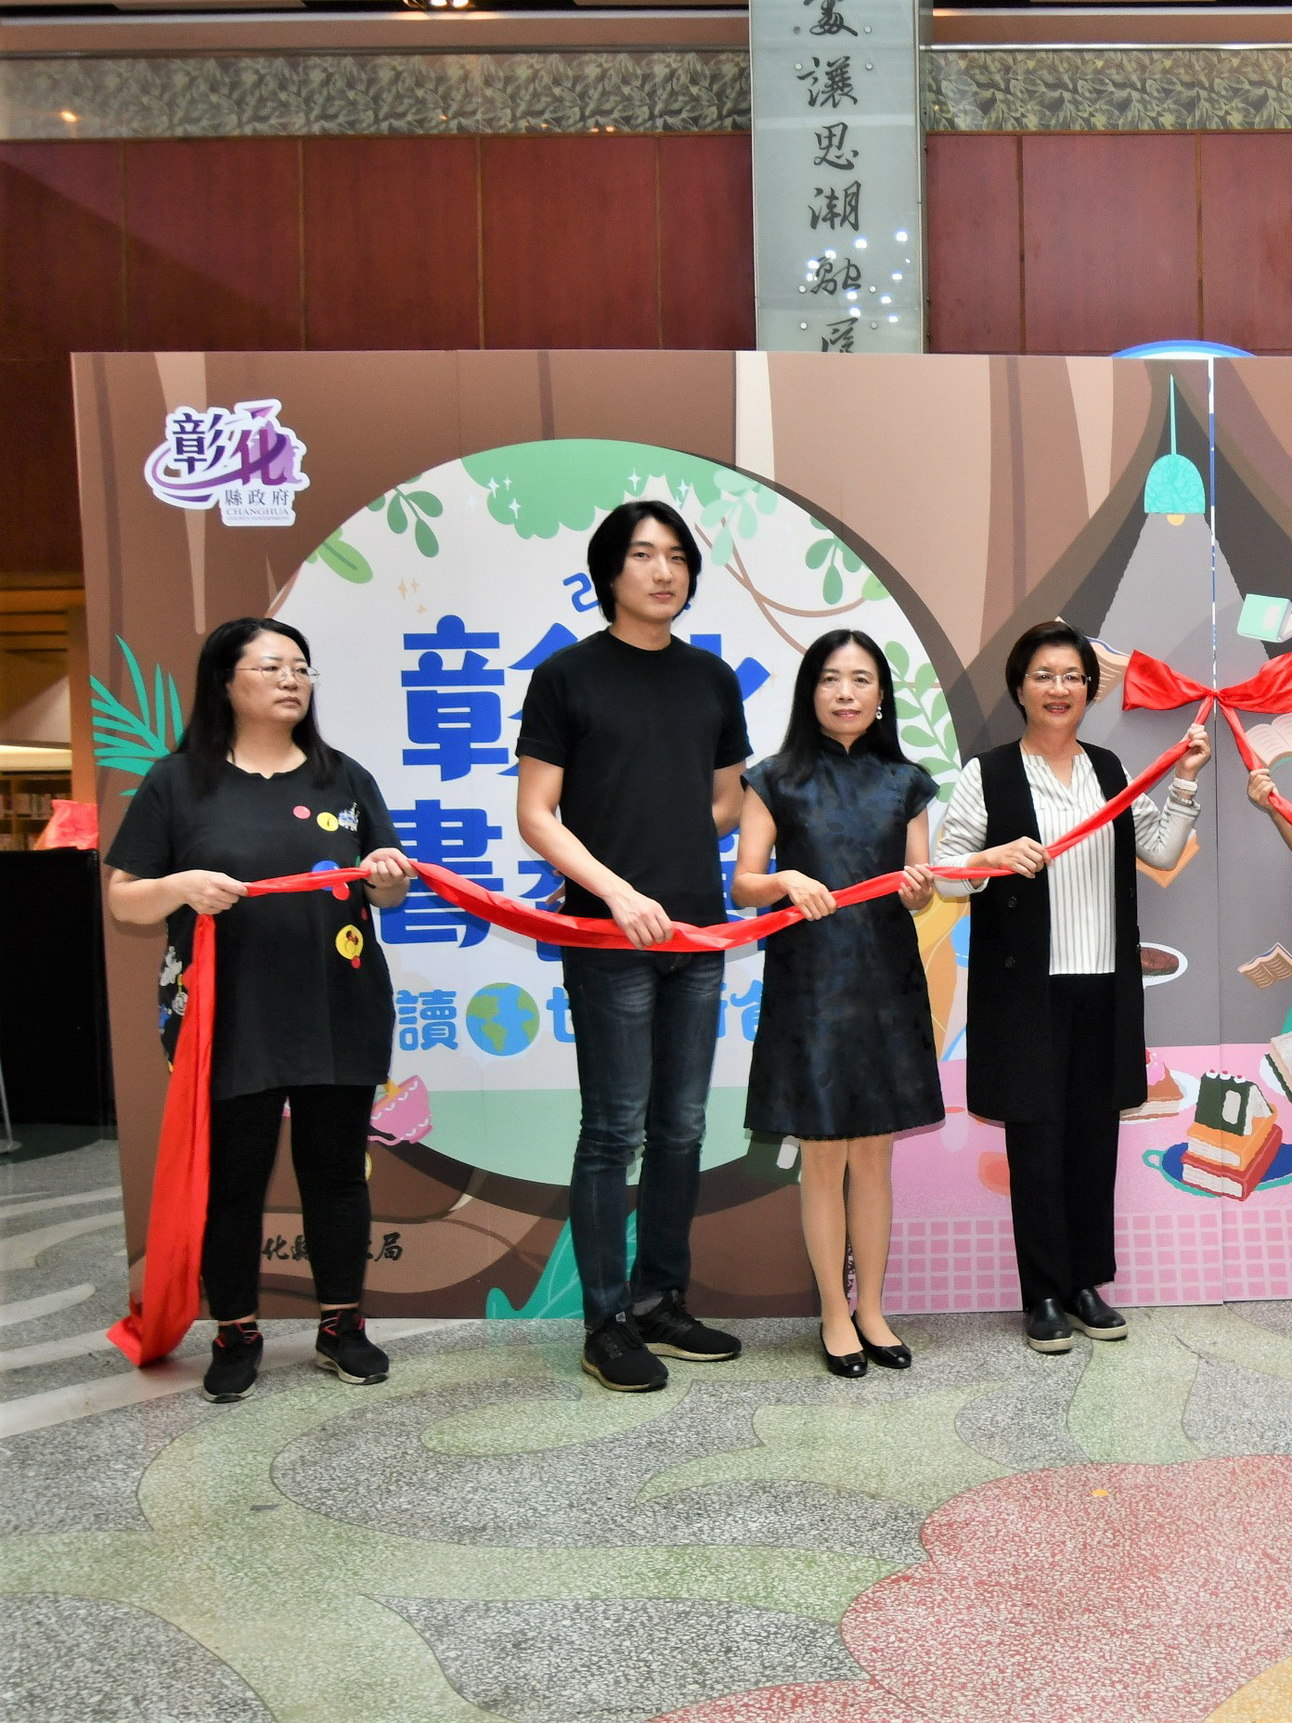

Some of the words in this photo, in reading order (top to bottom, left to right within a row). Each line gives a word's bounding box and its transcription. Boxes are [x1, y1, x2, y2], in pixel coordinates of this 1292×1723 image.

[172, 409, 291, 487] 彰化
[225, 488, 290, 506] 縣政府
[226, 508, 290, 516] CHANGHUA
[396, 989, 458, 1051] 讀
[261, 1231, 404, 1263] 化縣局
